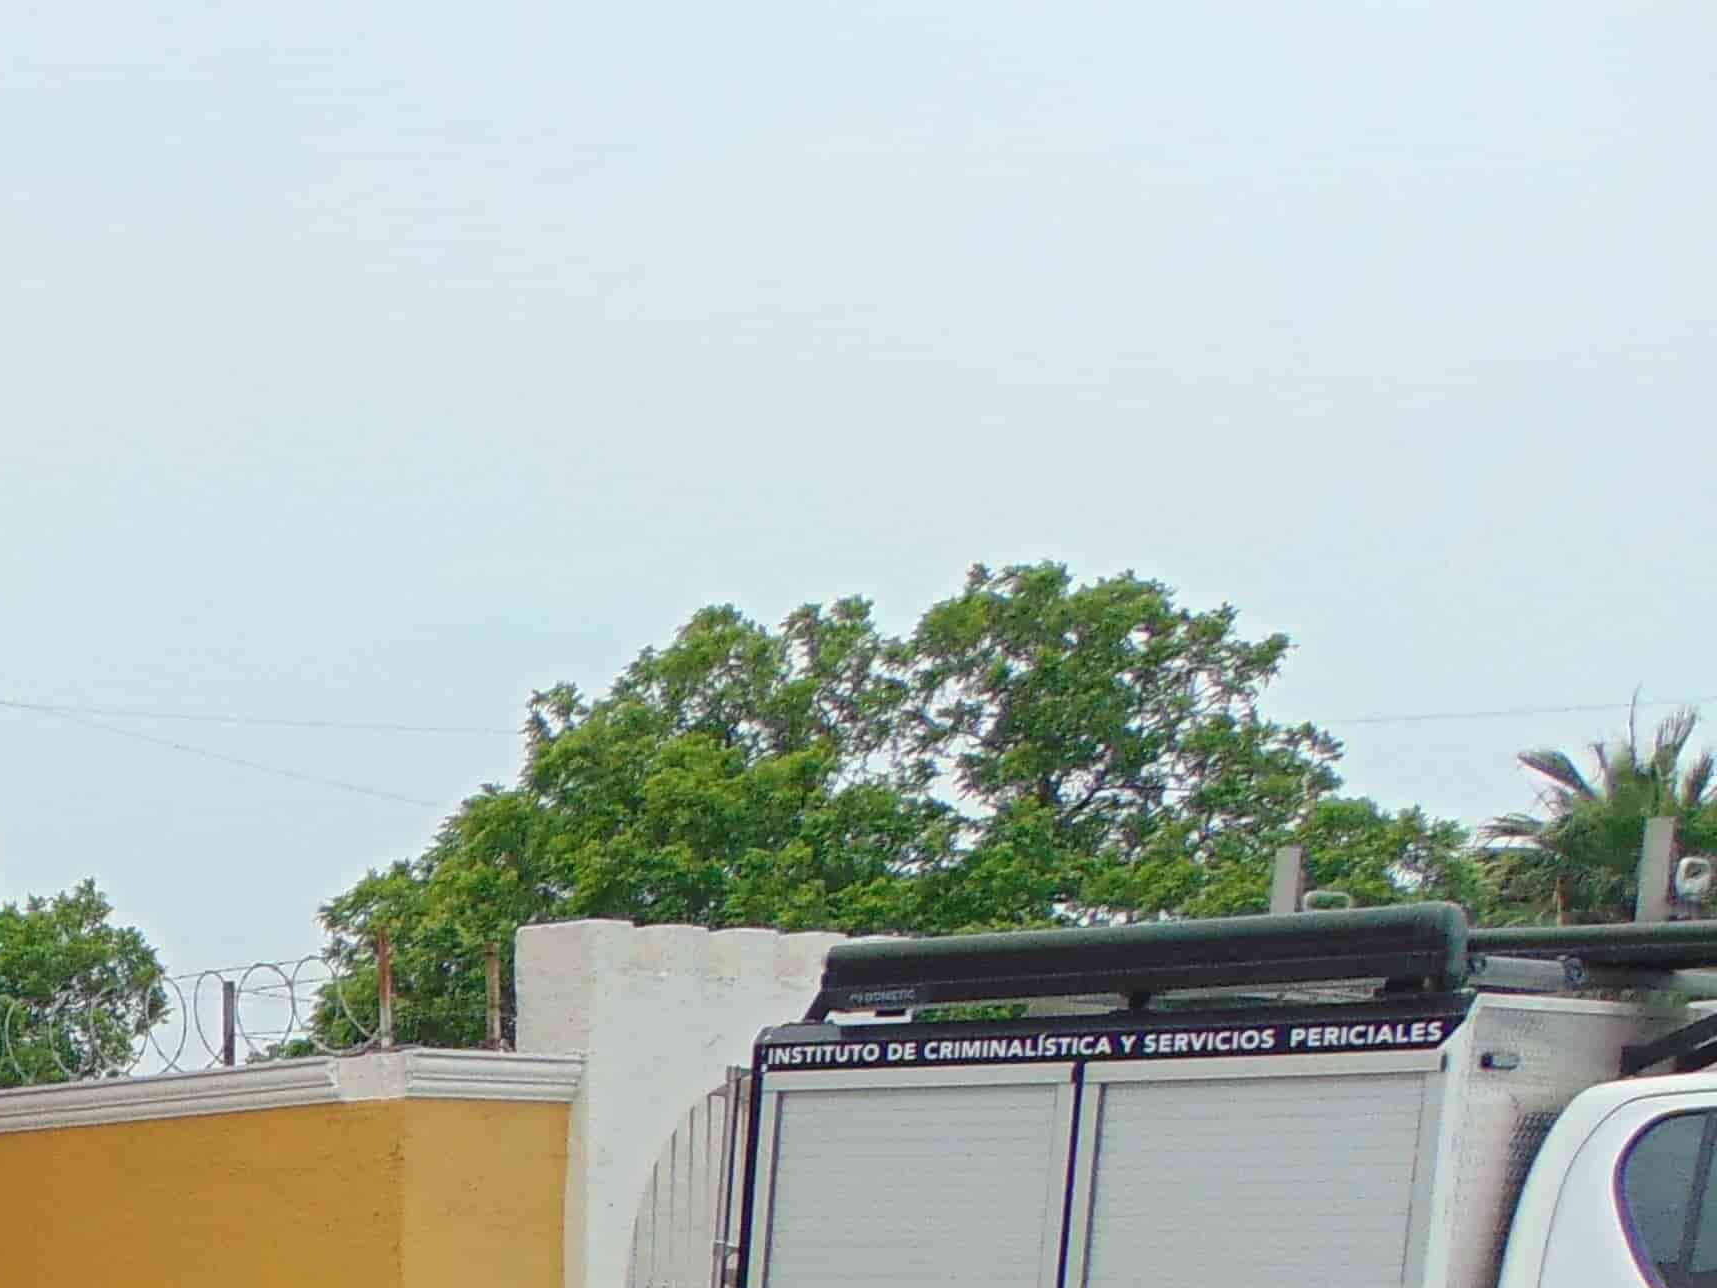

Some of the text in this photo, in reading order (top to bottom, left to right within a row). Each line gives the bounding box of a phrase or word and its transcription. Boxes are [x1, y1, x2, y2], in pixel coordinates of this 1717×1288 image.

[767, 1020, 1443, 1065] INSTITUTO DE CRIMINALÍSTICA Y SERVICIOS PERICIALES
